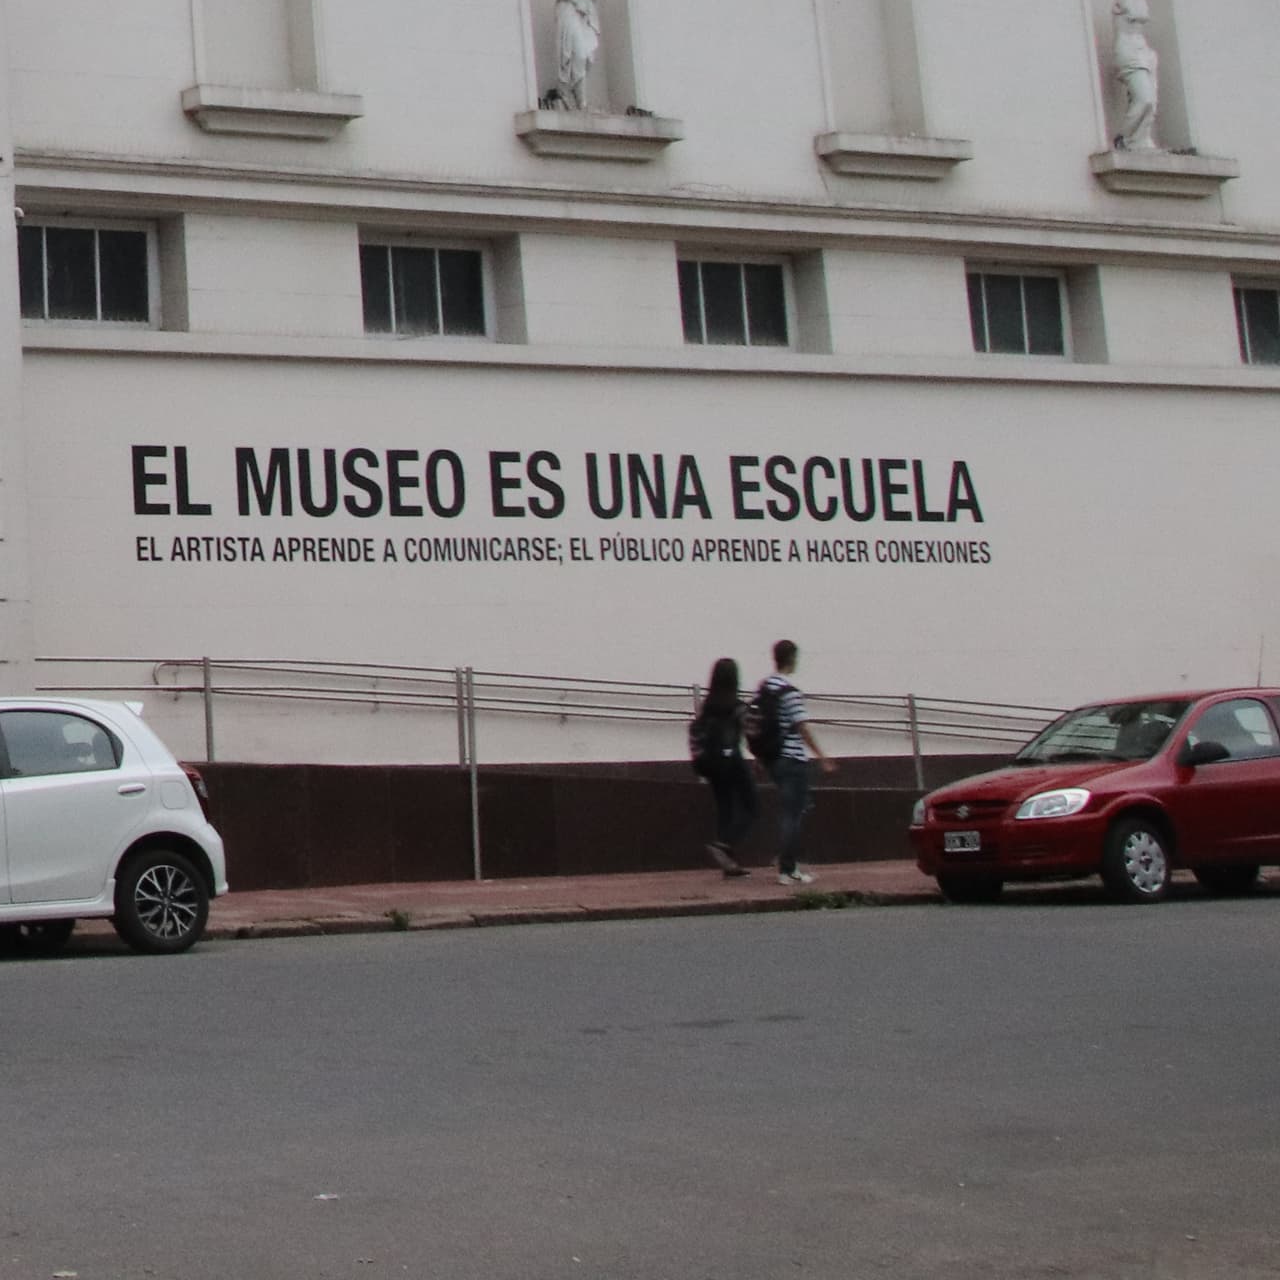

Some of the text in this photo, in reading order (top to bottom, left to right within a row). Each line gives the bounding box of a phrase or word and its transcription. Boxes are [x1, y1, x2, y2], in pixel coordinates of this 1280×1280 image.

[131, 444, 985, 523] EL MUSEO ES UNA ESCUELA
[135, 532, 992, 565] EL ARTISTA APRENDE A COMUNICARSE; EL PÚBLICO APRENDE A HACER CONEXIONES
